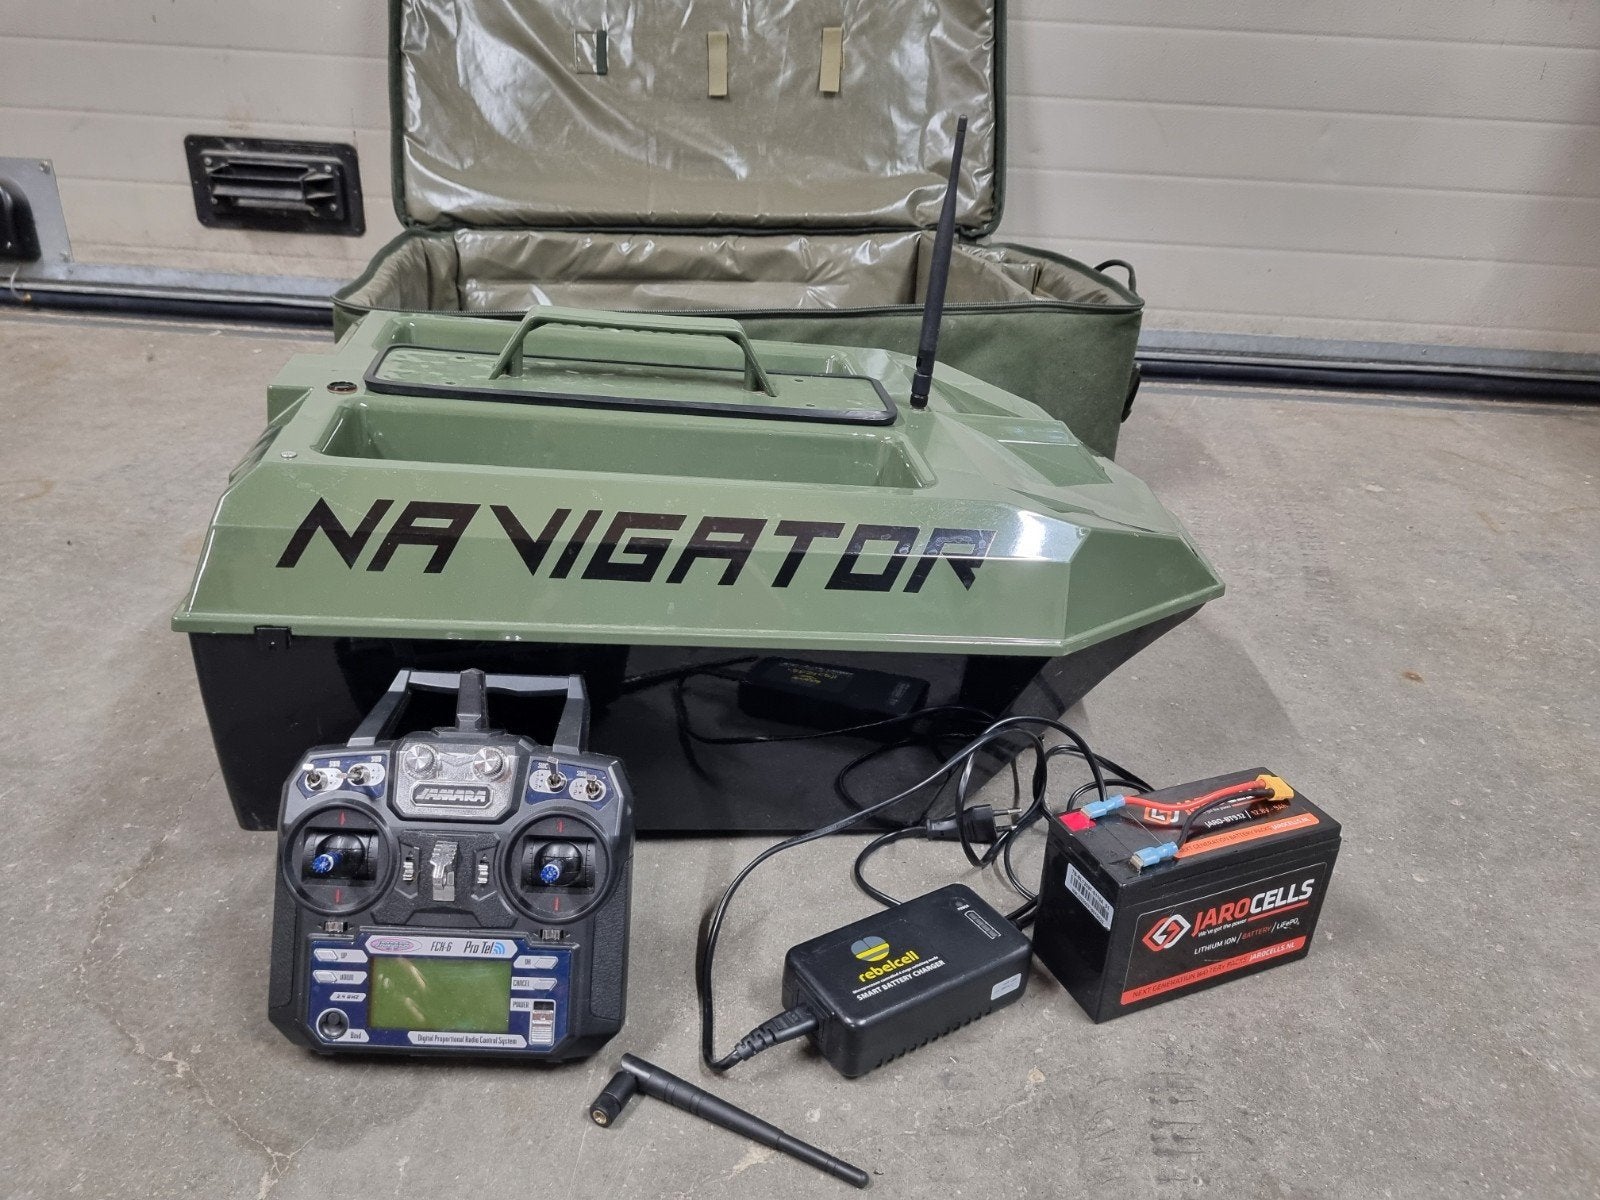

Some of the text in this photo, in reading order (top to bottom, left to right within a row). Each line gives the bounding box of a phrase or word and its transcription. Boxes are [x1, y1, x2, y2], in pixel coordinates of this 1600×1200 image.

[276, 497, 996, 593] NAVIGATOR
[415, 788, 486, 803] JAMARA
[1191, 878, 1315, 938] JAROCELLS
[1230, 918, 1248, 929] power
[464, 940, 479, 954] Pro
[480, 942, 494, 954] Tel
[1194, 940, 1223, 955] LITHIUM
[1224, 936, 1237, 946] ION
[1241, 926, 1271, 940] BATTERY
[856, 986, 882, 1001] SMART
[882, 974, 913, 991] BATTERY
[912, 960, 946, 977] CHARGER
[859, 950, 920, 983] rebelcell
[1132, 941, 1296, 998] NEXT GENERATION BATTERY PACKS JAROCELLS.NL
[512, 1001, 530, 1009] POWER
[417, 1033, 518, 1046] Digital Proportional Radio Control System
